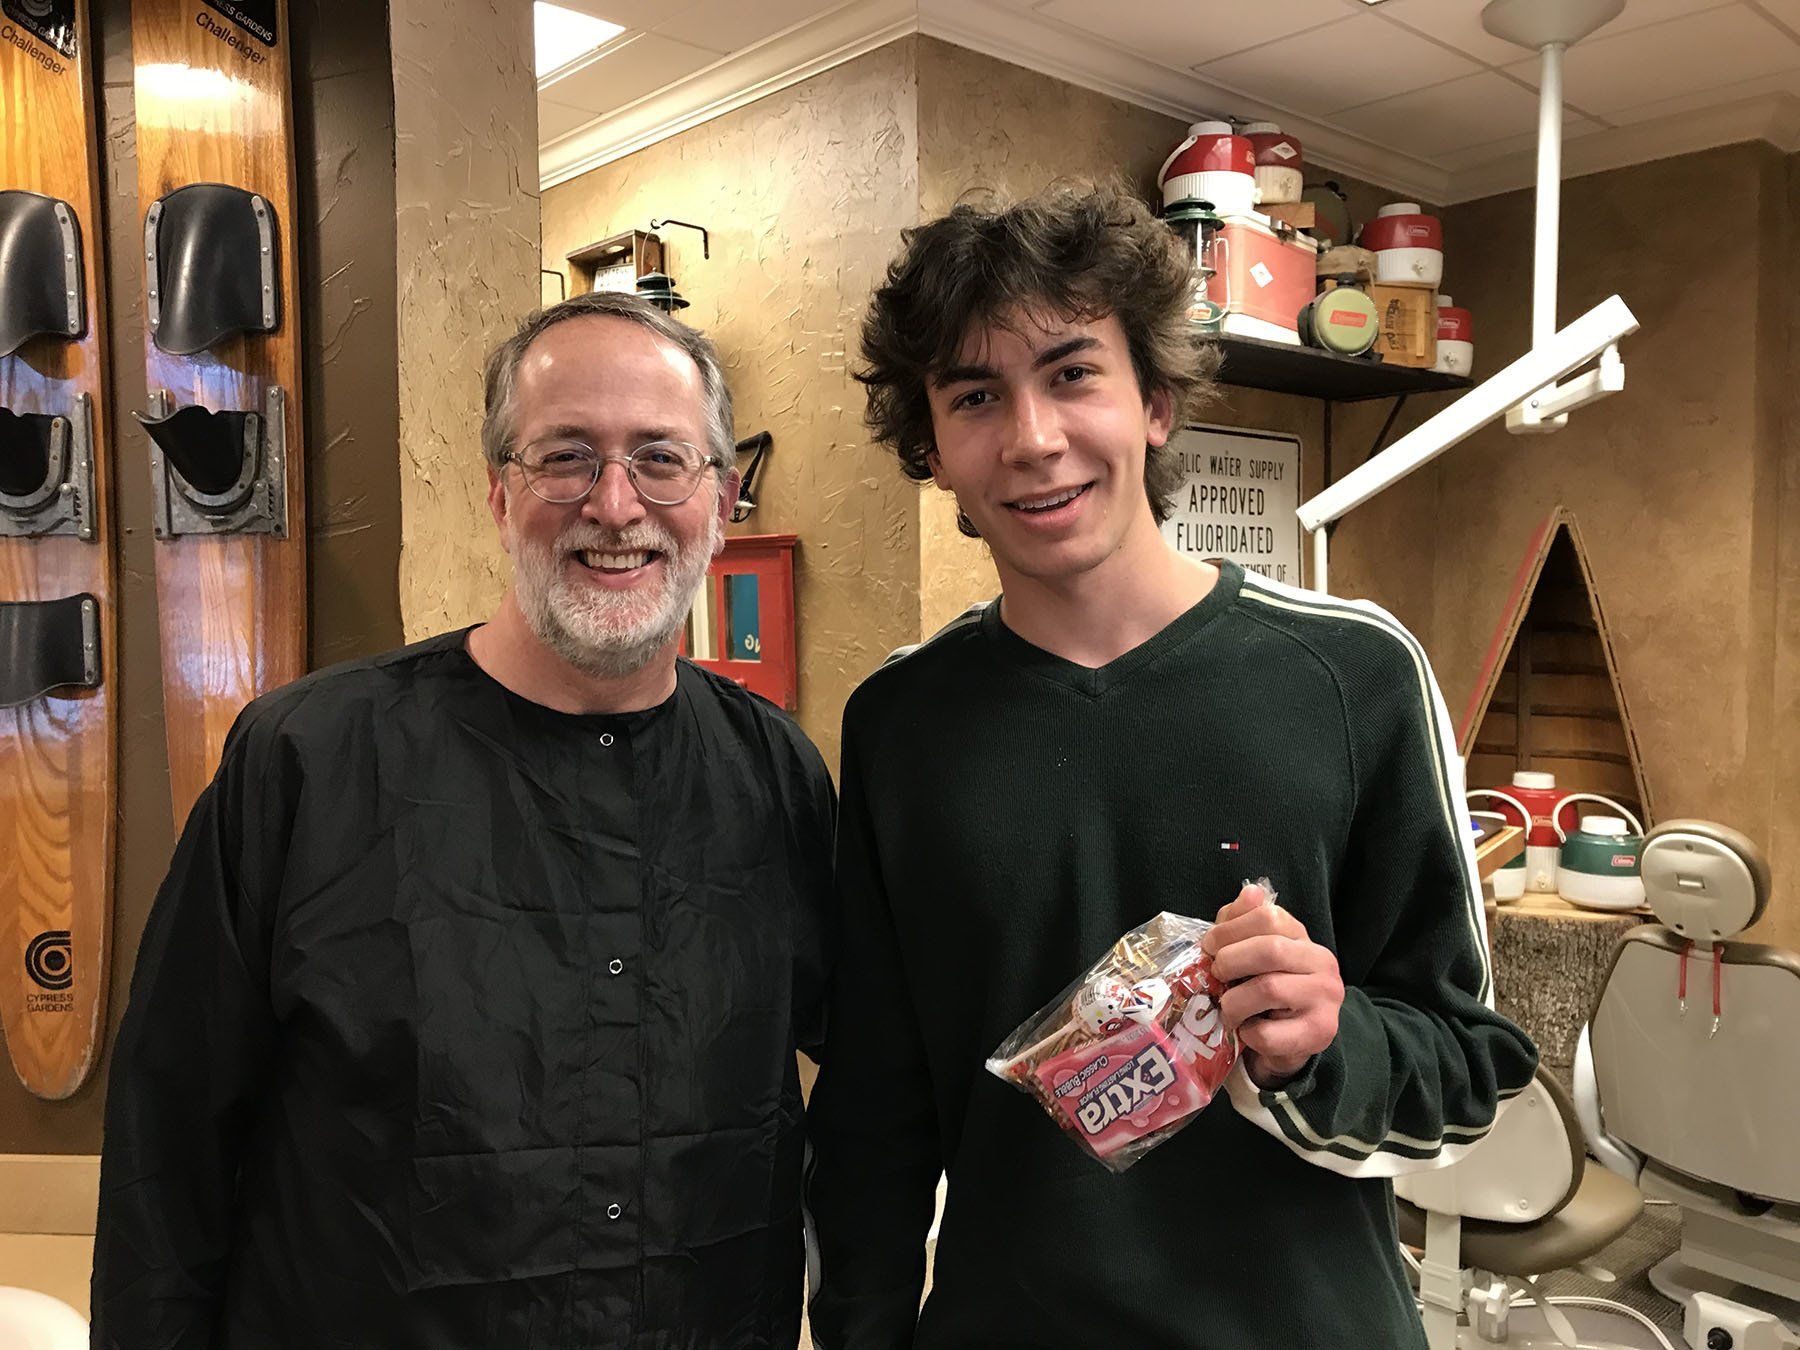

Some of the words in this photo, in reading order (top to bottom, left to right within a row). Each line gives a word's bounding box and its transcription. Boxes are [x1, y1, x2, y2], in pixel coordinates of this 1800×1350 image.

[196, 12, 267, 64] Challenger
[235, 12, 273, 41] GARDENS
[1, 25, 66, 75] Challenger
[1178, 452, 1201, 474] BLIC
[1210, 456, 1241, 477] WATER
[1249, 459, 1285, 480] SUPPLY
[1188, 484, 1265, 516] APPROVED
[1176, 522, 1274, 554] FLUORIDATED
[1276, 564, 1287, 582] OF
[26, 993, 74, 1002] CYPRESS
[26, 1003, 74, 1012] GARDENS
[1080, 1055, 1108, 1080] CLASSIC
[1055, 1074, 1081, 1098] BUBBLE
[1077, 1045, 1175, 1134] Extra
